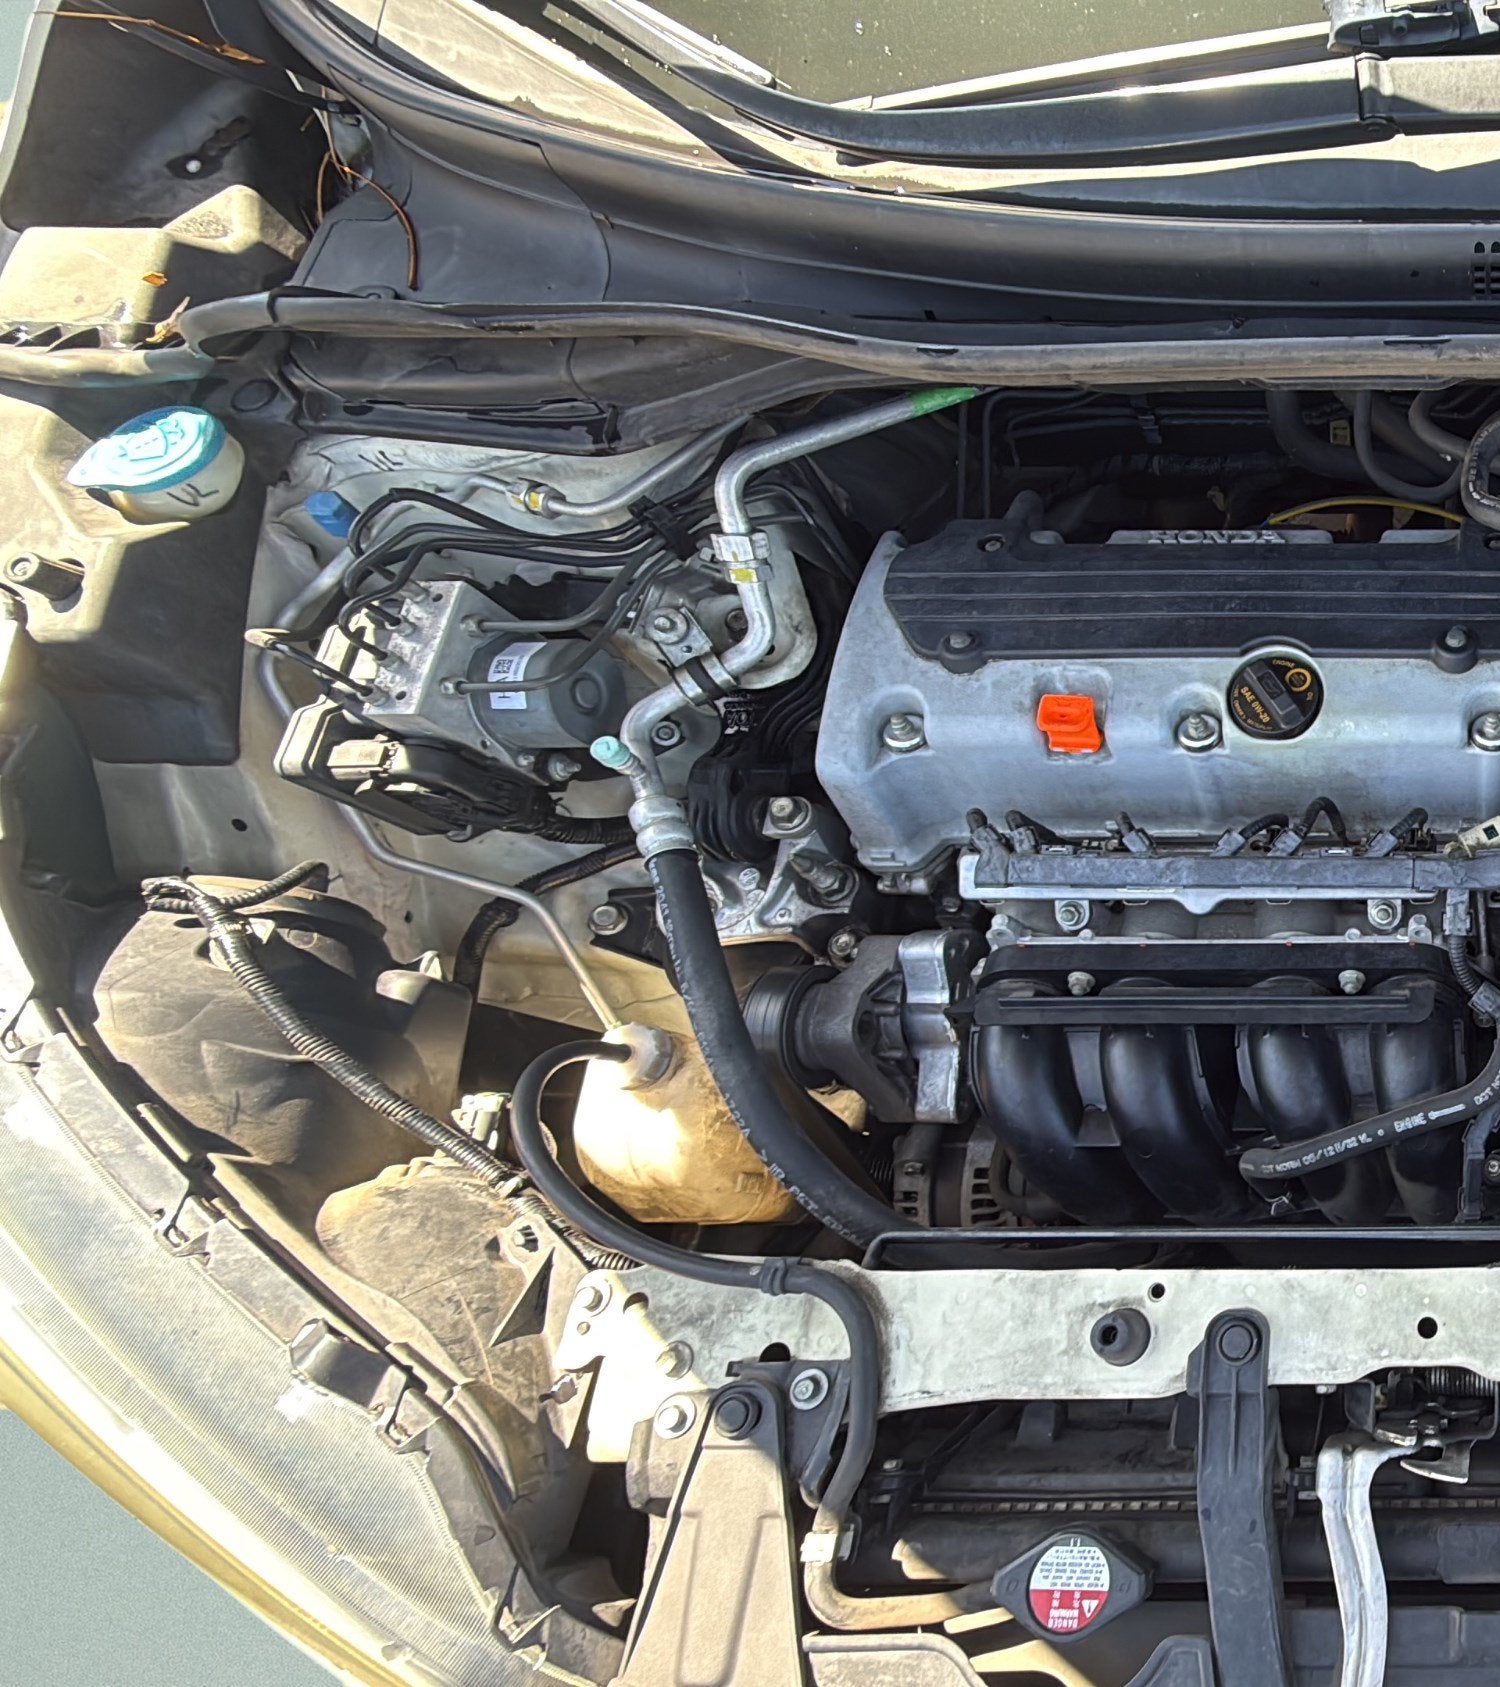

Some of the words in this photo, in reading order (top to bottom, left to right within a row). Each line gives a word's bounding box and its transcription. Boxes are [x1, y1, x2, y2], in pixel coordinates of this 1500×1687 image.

[1147, 529, 1286, 545] HONDA
[1272, 658, 1296, 669] ENGINE
[1240, 686, 1254, 704] SAE
[1251, 699, 1271, 723] 0W-20
[1049, 1609, 1079, 1618] WARNING
[1047, 1618, 1078, 1629] DANGER
